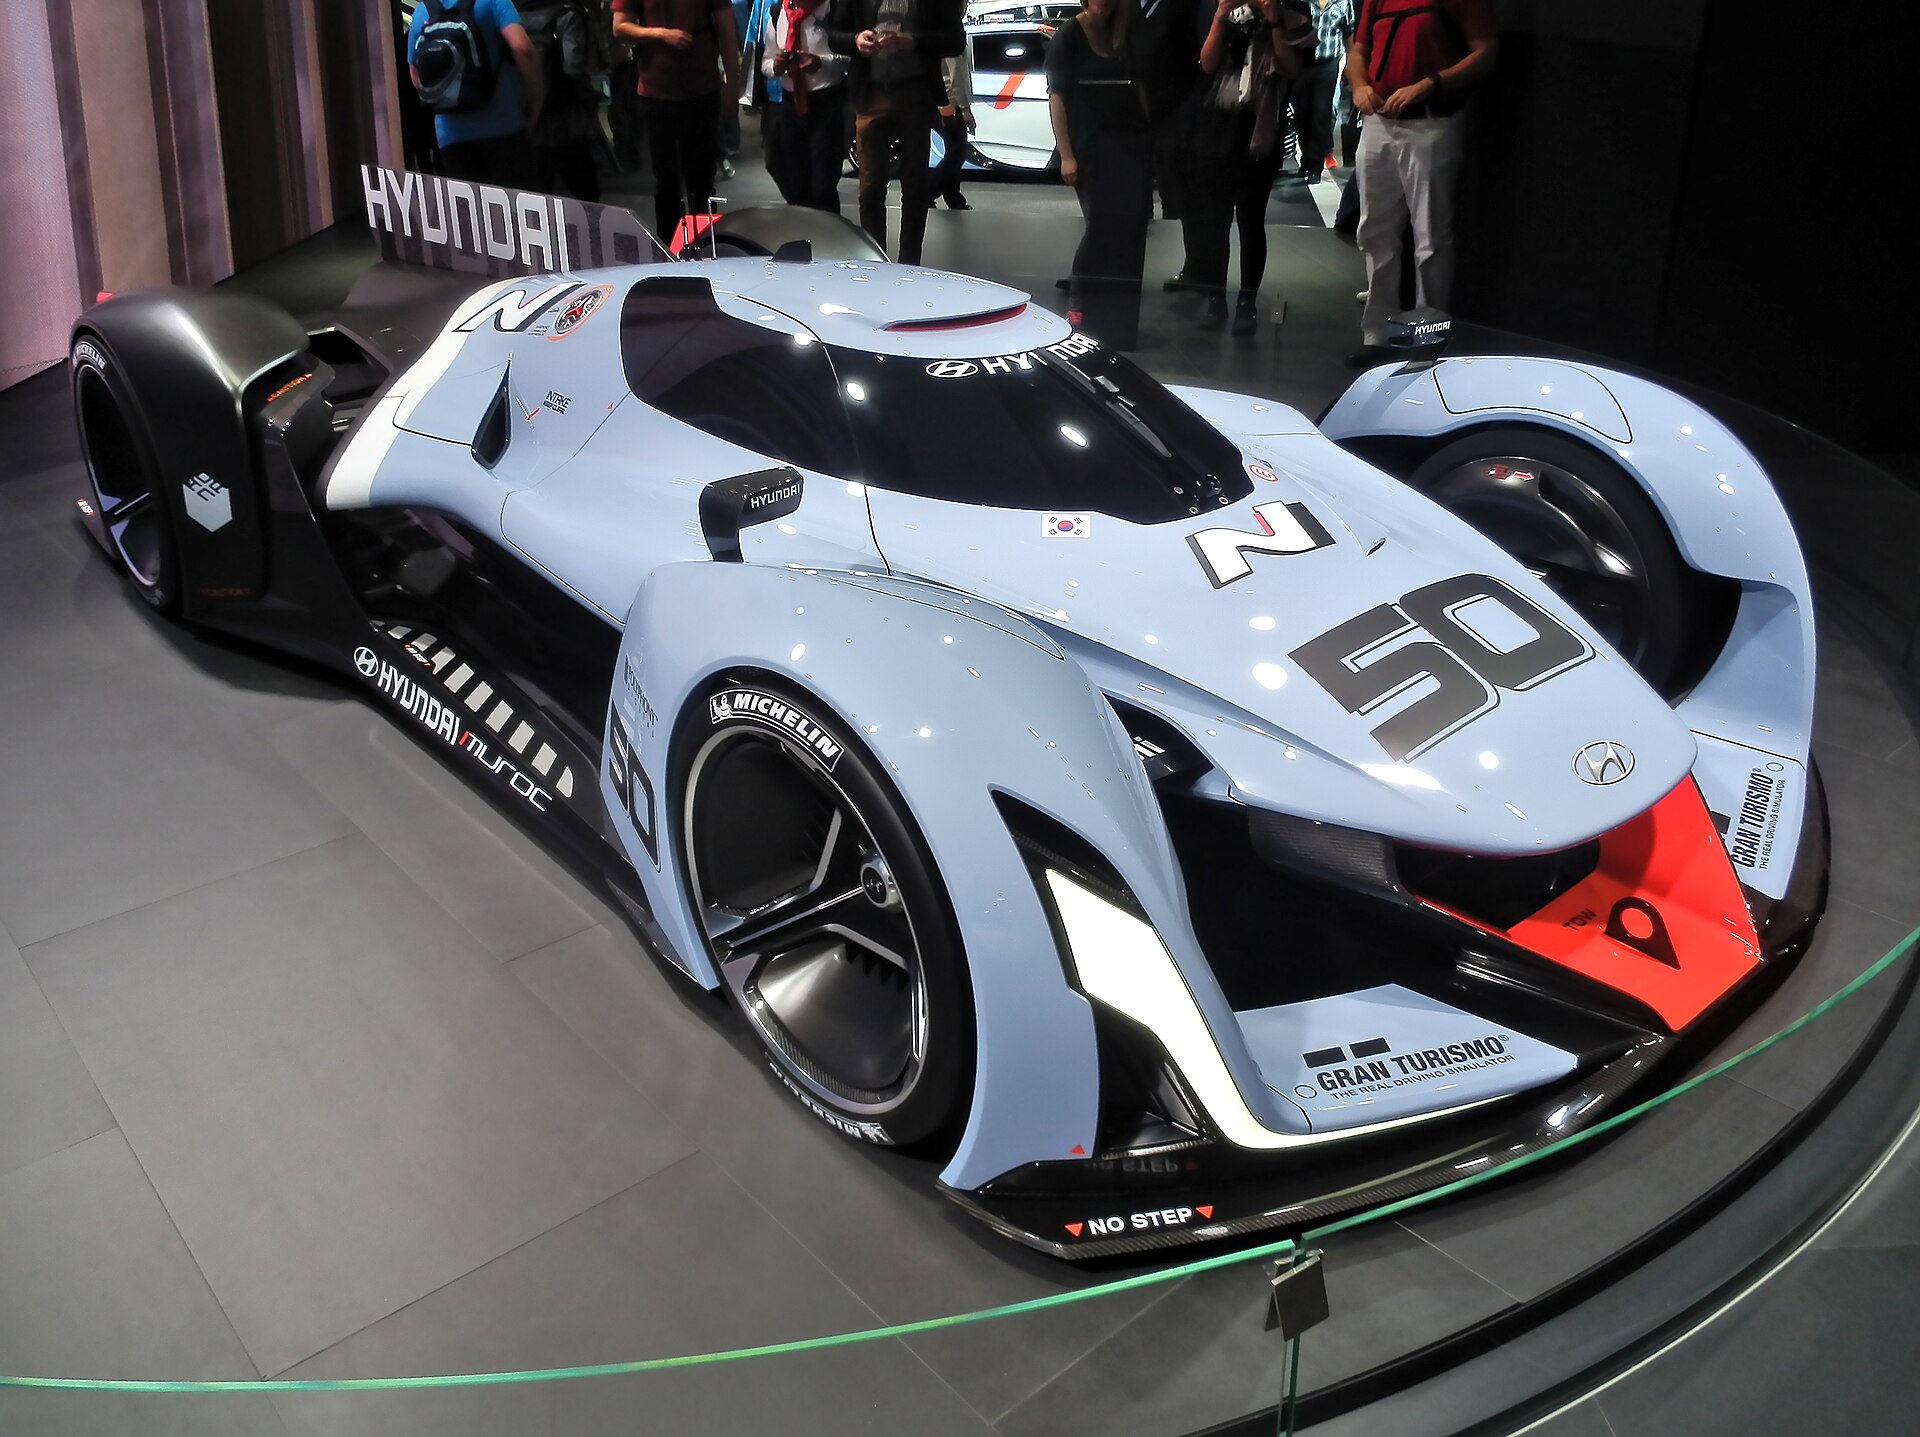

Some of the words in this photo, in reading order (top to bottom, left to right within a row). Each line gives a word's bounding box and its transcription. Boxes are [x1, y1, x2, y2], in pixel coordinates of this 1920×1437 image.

[360, 164, 571, 274] HYUNDAI
[451, 281, 588, 333] N
[1414, 320, 1451, 335] HYUNDAI
[979, 332, 1101, 375] HYNDAI
[750, 484, 800, 509] HYUNDAI
[1185, 500, 1336, 589] N
[1287, 573, 1597, 763] 50
[377, 660, 460, 746] HYUNDAI
[733, 693, 840, 759] MICHELIN
[608, 697, 662, 873] 50
[1773, 779, 1786, 814] SIMULATOR
[1766, 813, 1779, 839] DRIVING
[1730, 827, 1762, 868] GRAN
[1759, 857, 1771, 870] THE
[1762, 839, 1774, 857] REAL
[1562, 908, 1597, 931] TOW
[1316, 1059, 1392, 1092] GRAN
[1331, 1087, 1357, 1100] THE
[1360, 1082, 1393, 1094] REAL
[1393, 1071, 1445, 1087] DRIVING
[1448, 1055, 1516, 1075] SIMULATOR
[1087, 1217, 1125, 1235] NO
[1131, 1207, 1192, 1229] STEP
